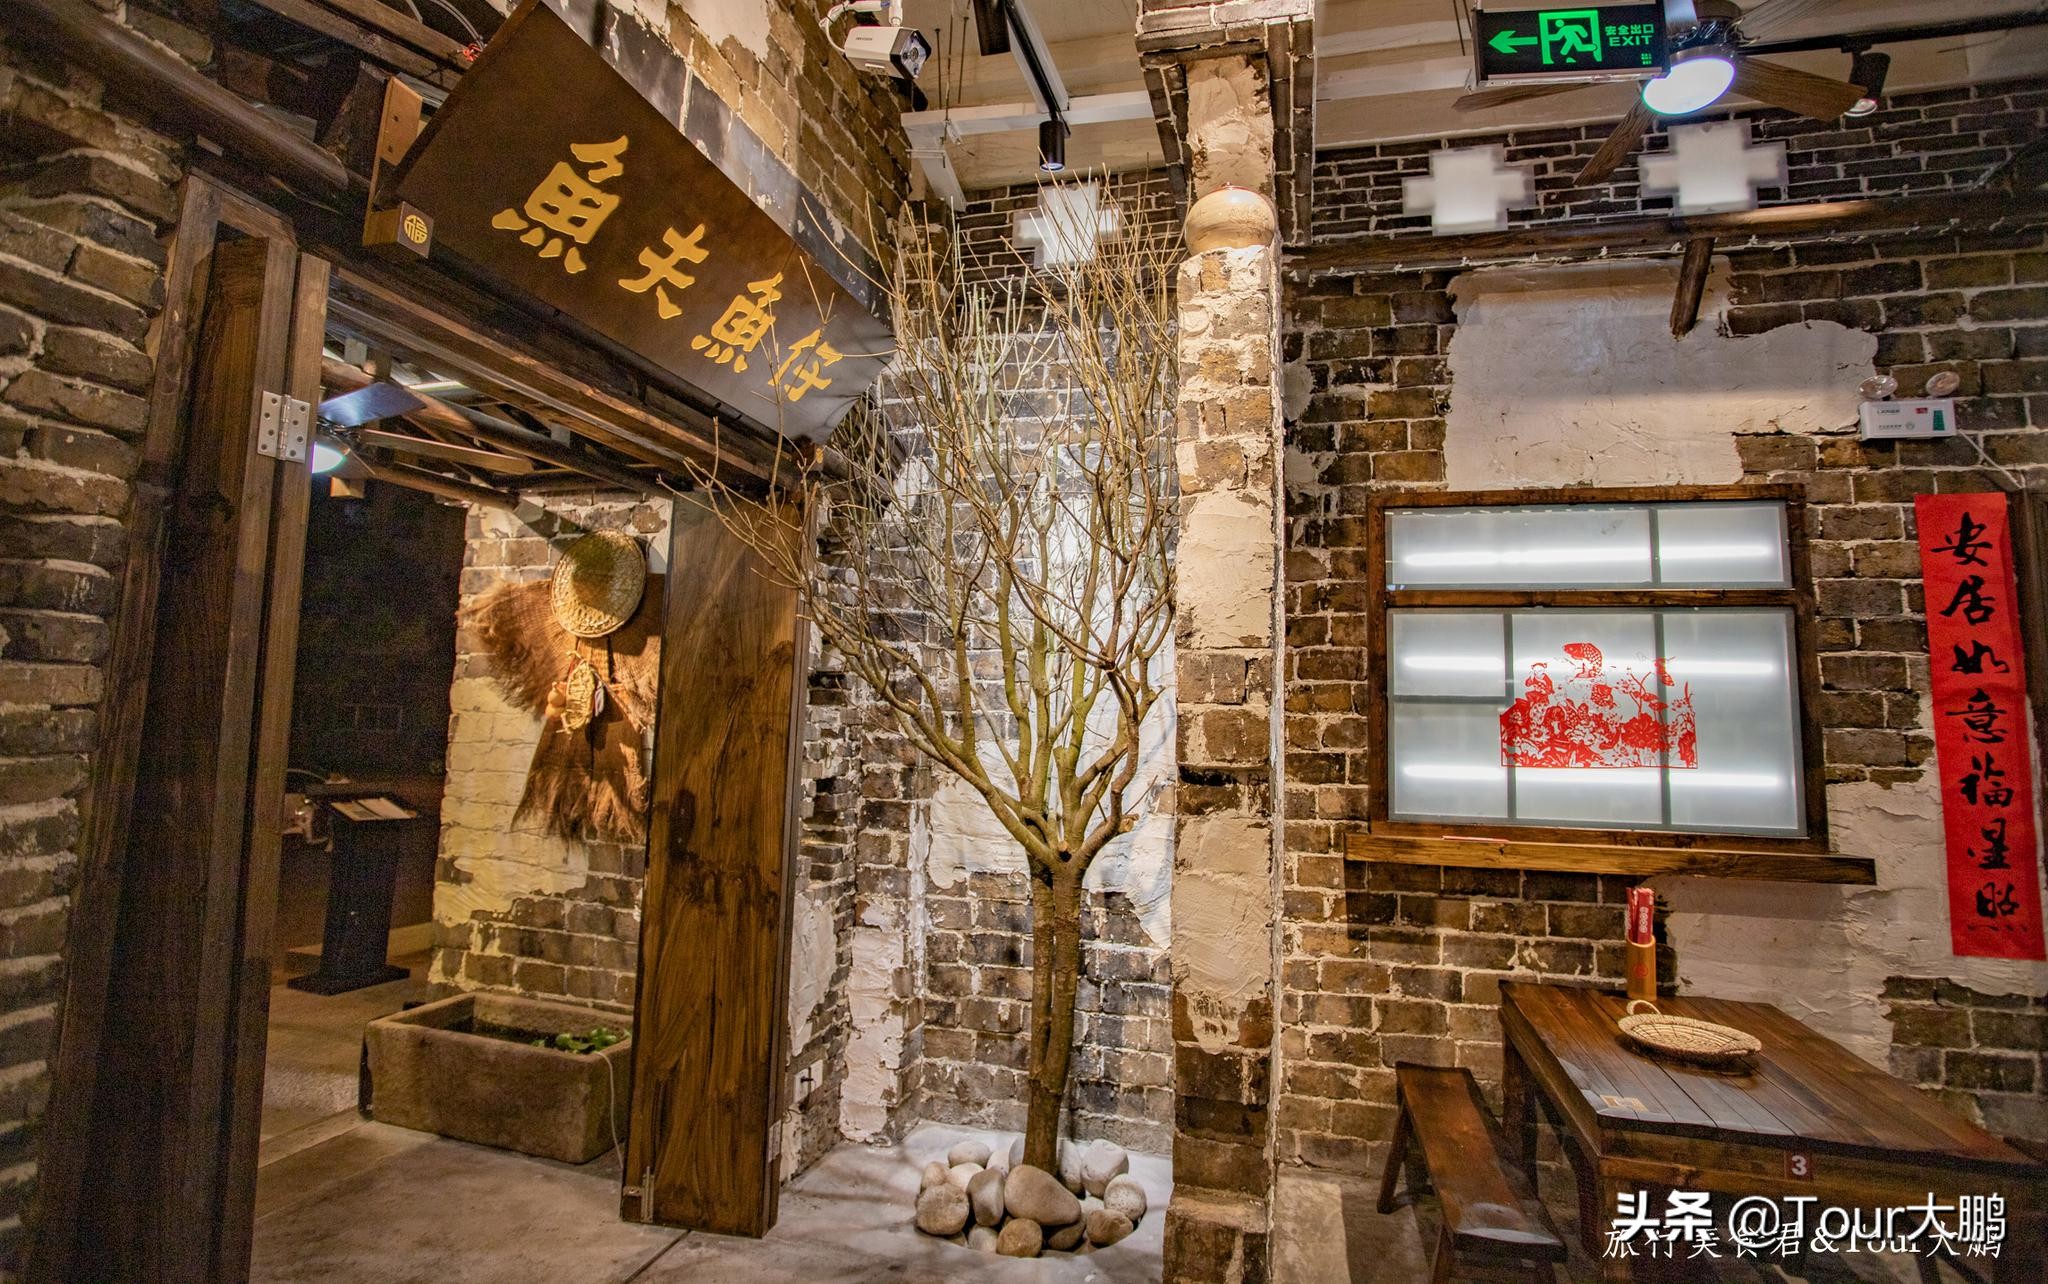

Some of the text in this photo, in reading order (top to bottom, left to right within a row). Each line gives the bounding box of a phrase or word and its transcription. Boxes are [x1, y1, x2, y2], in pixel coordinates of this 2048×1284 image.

[1605, 24, 1654, 36] 安全出口
[1609, 35, 1652, 46] EXIT
[404, 215, 428, 244] 福
[491, 135, 843, 401] 魚夫魚仔
[1930, 512, 2028, 932] 安居如意福星照
[1791, 1154, 1807, 1176] 3
